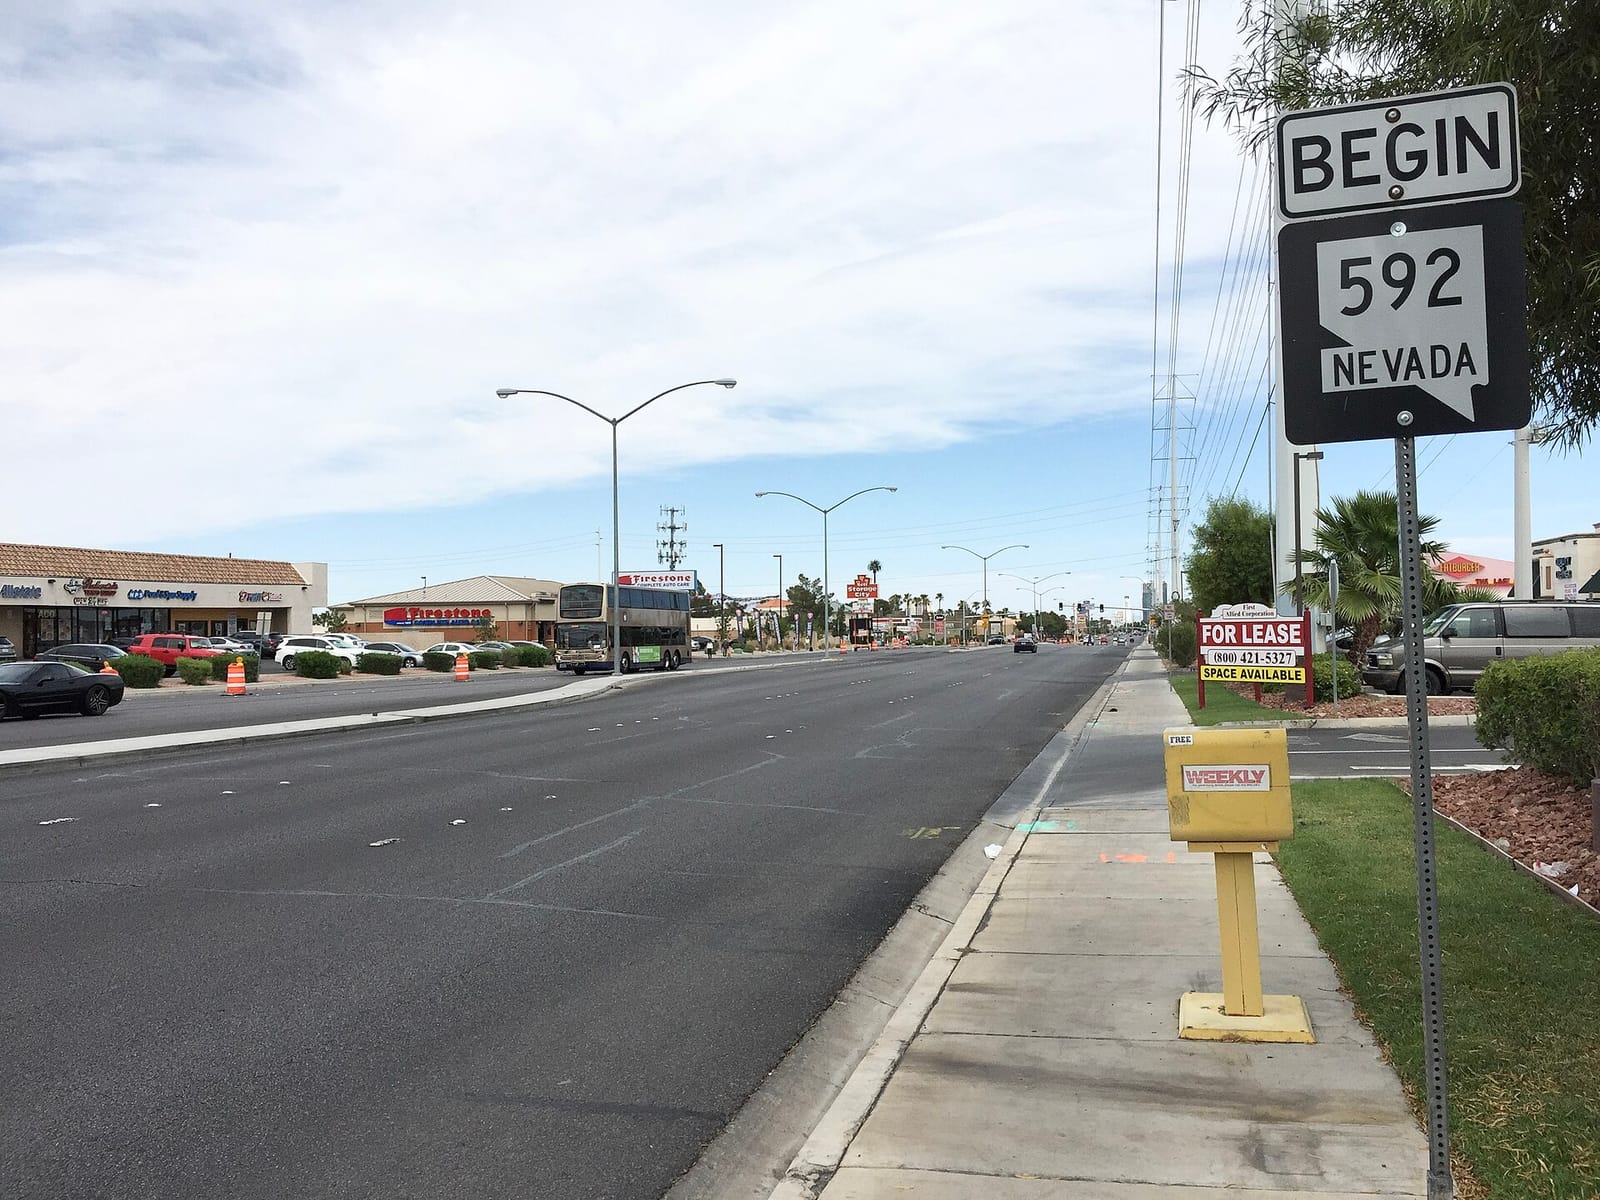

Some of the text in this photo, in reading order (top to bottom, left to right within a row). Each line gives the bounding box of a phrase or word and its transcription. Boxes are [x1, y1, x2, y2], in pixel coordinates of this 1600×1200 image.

[1291, 111, 1500, 194] BEGIN
[1340, 247, 1463, 317] 592
[1332, 342, 1477, 387] NEVADA
[633, 575, 691, 584] Firestone
[0, 585, 42, 599] Allstate
[408, 607, 491, 620] Firestone
[1202, 623, 1301, 644] FOR LEASE
[1213, 651, 1292, 664] (800) 421-5327
[1204, 668, 1302, 681] SPACE AVAILABLE
[1170, 735, 1192, 744] FREE
[1185, 769, 1266, 784] WEEKLY
